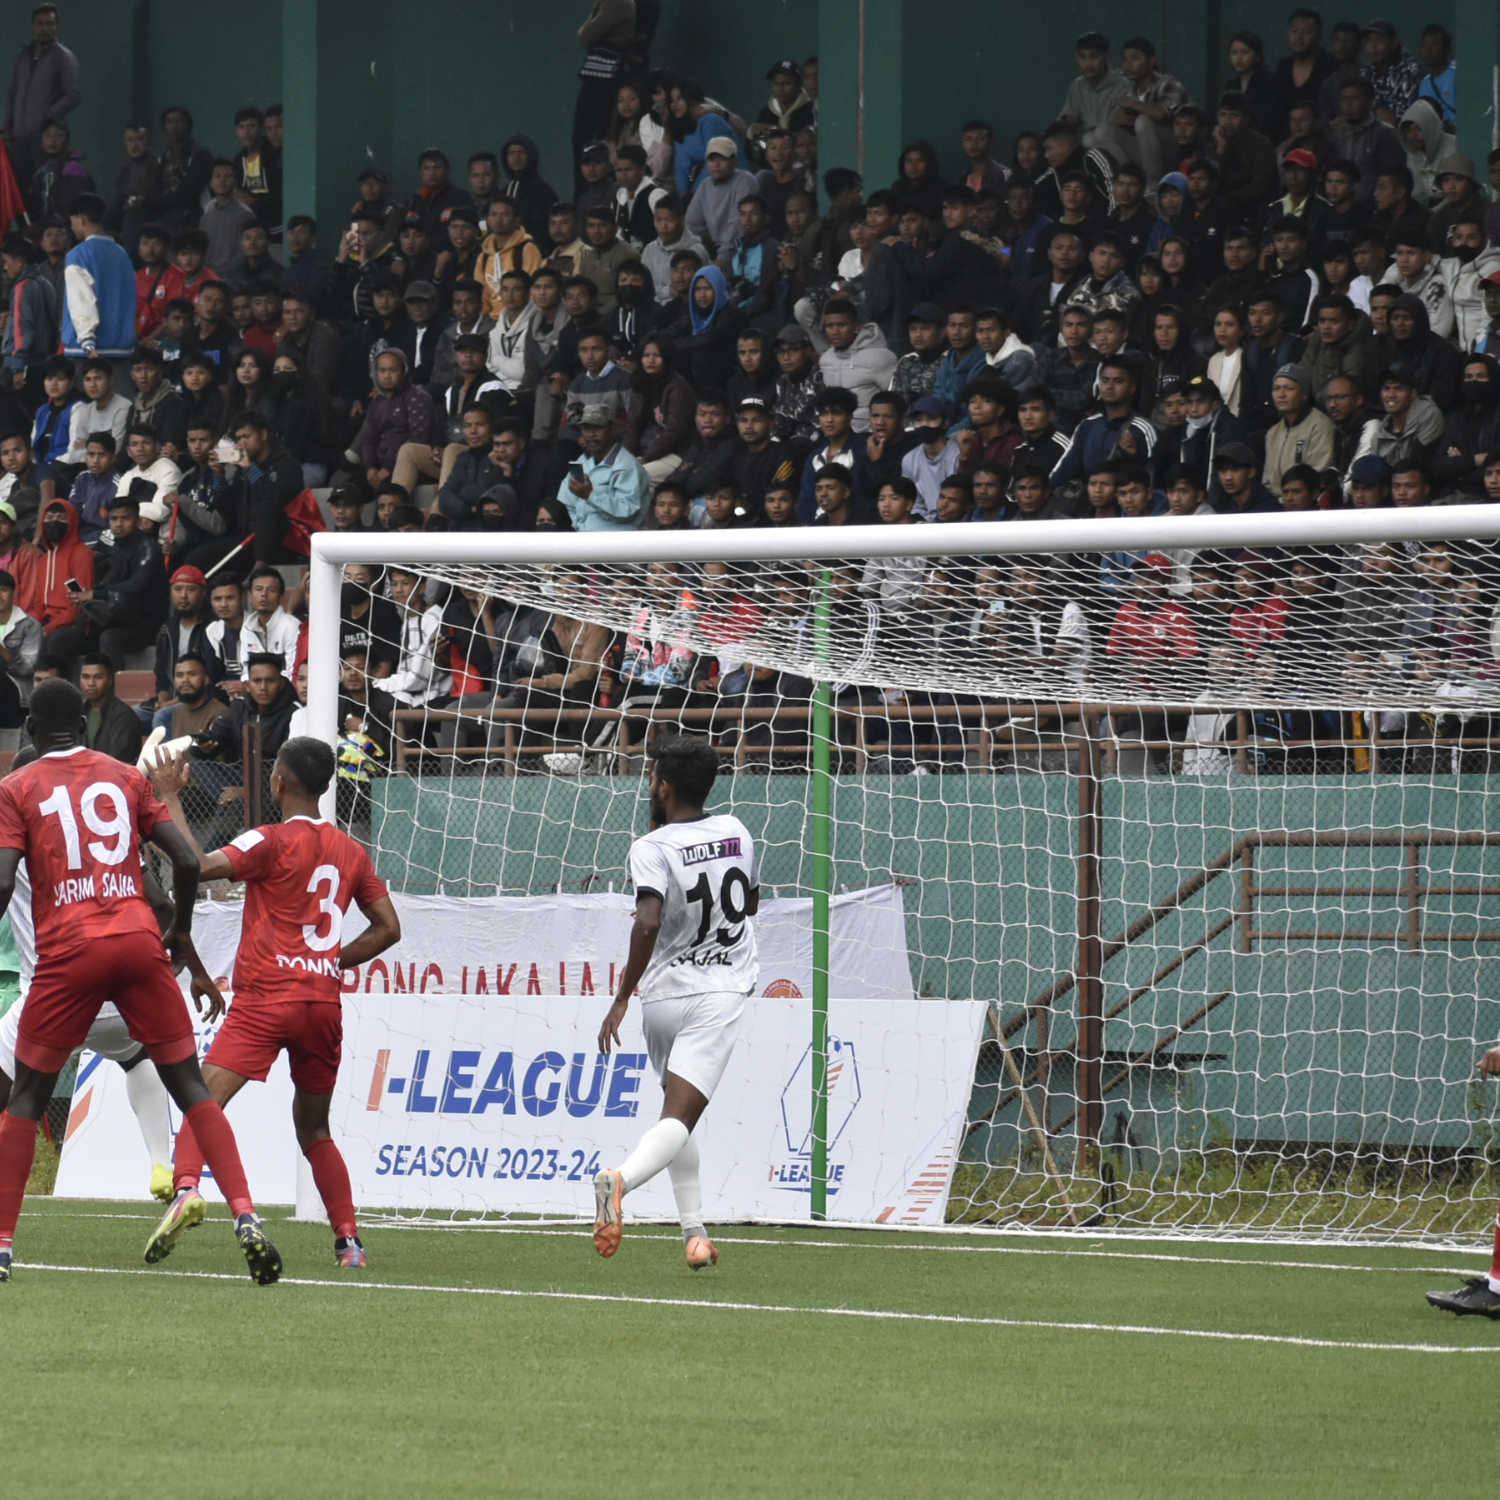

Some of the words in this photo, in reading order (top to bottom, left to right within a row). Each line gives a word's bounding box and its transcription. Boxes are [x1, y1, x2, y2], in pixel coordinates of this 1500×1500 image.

[38, 781, 132, 871] 19
[302, 864, 343, 952] 3
[685, 866, 751, 947] 19
[366, 1048, 648, 1119] I-LEAGUE
[375, 1144, 489, 1179] SEASON
[493, 1148, 602, 1182] 2023-24
[768, 1164, 846, 1183] I-LEAUE
